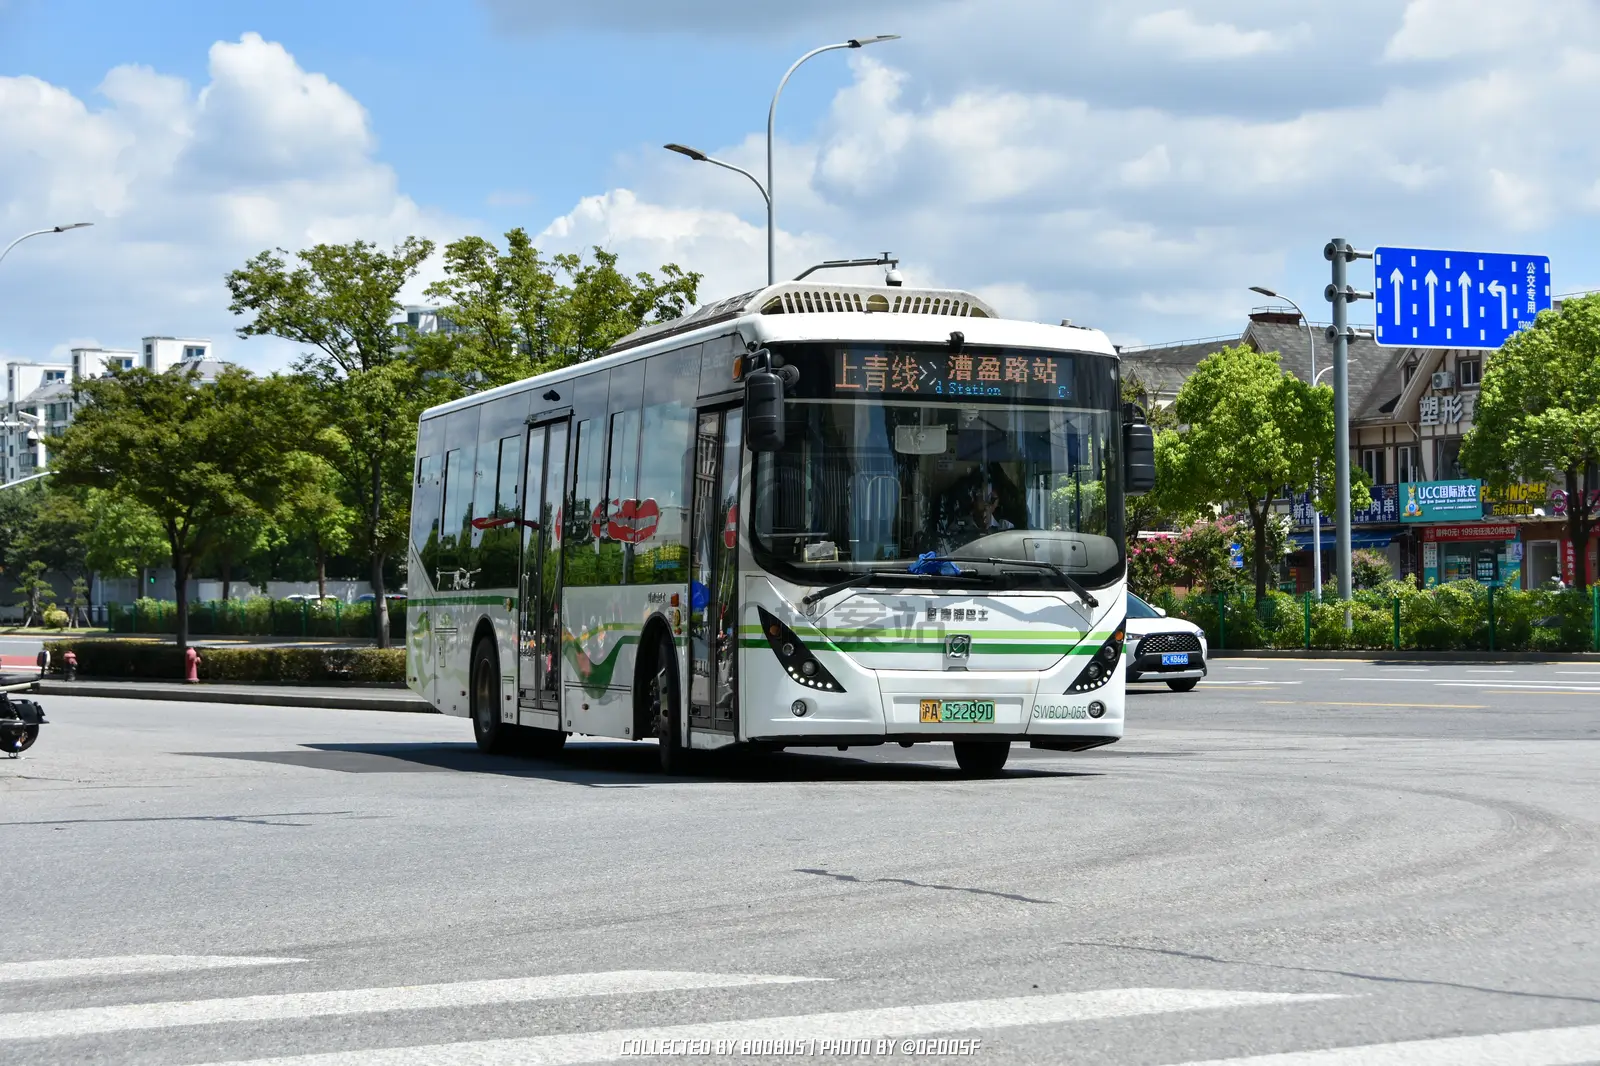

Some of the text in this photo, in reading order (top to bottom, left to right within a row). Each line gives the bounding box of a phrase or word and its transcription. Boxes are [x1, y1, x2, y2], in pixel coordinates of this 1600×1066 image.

[1526, 262, 1536, 314] 公交专用
[835, 353, 1058, 392] 上青线 漕盈路站
[948, 382, 1002, 396] Station
[1419, 393, 1477, 426] 塑形
[1418, 485, 1477, 499] UCC国际洗衣
[945, 703, 993, 720] 52289D
[1033, 705, 1087, 719] SWBCD-055
